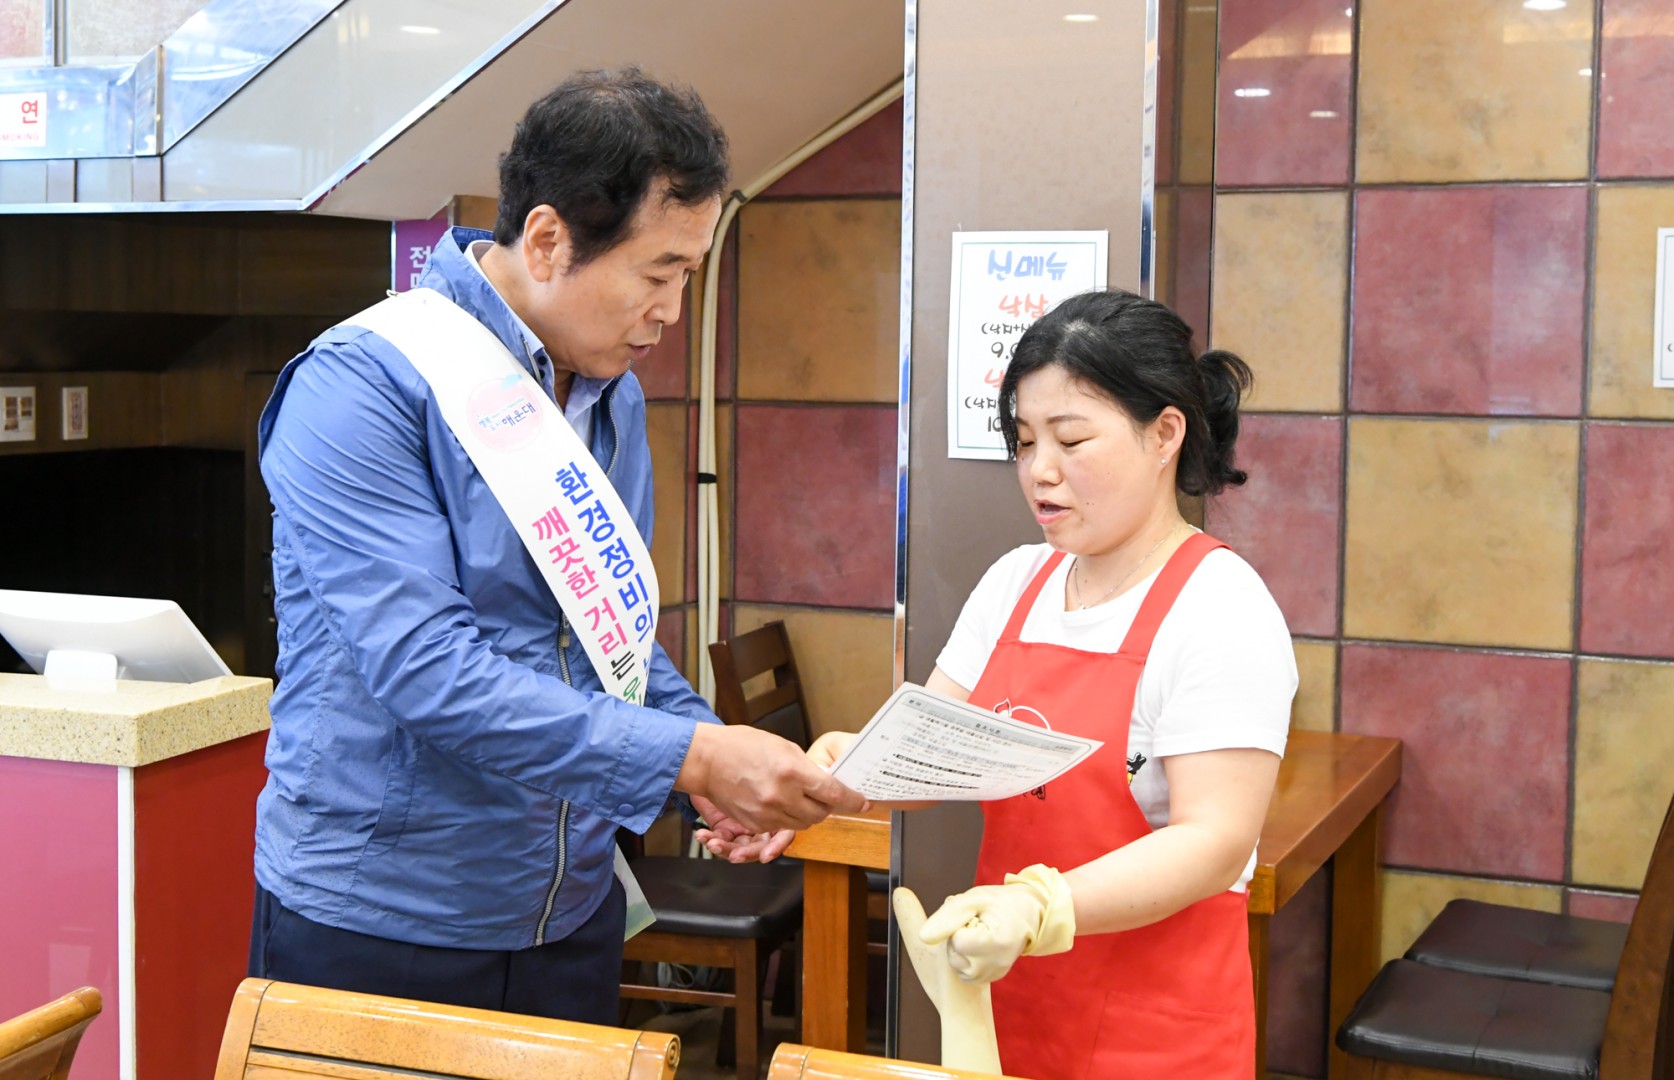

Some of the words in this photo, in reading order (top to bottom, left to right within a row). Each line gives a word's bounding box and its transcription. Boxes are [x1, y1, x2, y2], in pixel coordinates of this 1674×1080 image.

[0, 132, 39, 141] MOKING
[409, 246, 433, 268] 전
[987, 249, 1068, 281] 신메뉴
[554, 461, 654, 643] 환경정비의
[531, 506, 600, 600] 깨끗한
[583, 596, 636, 681] 거리는
